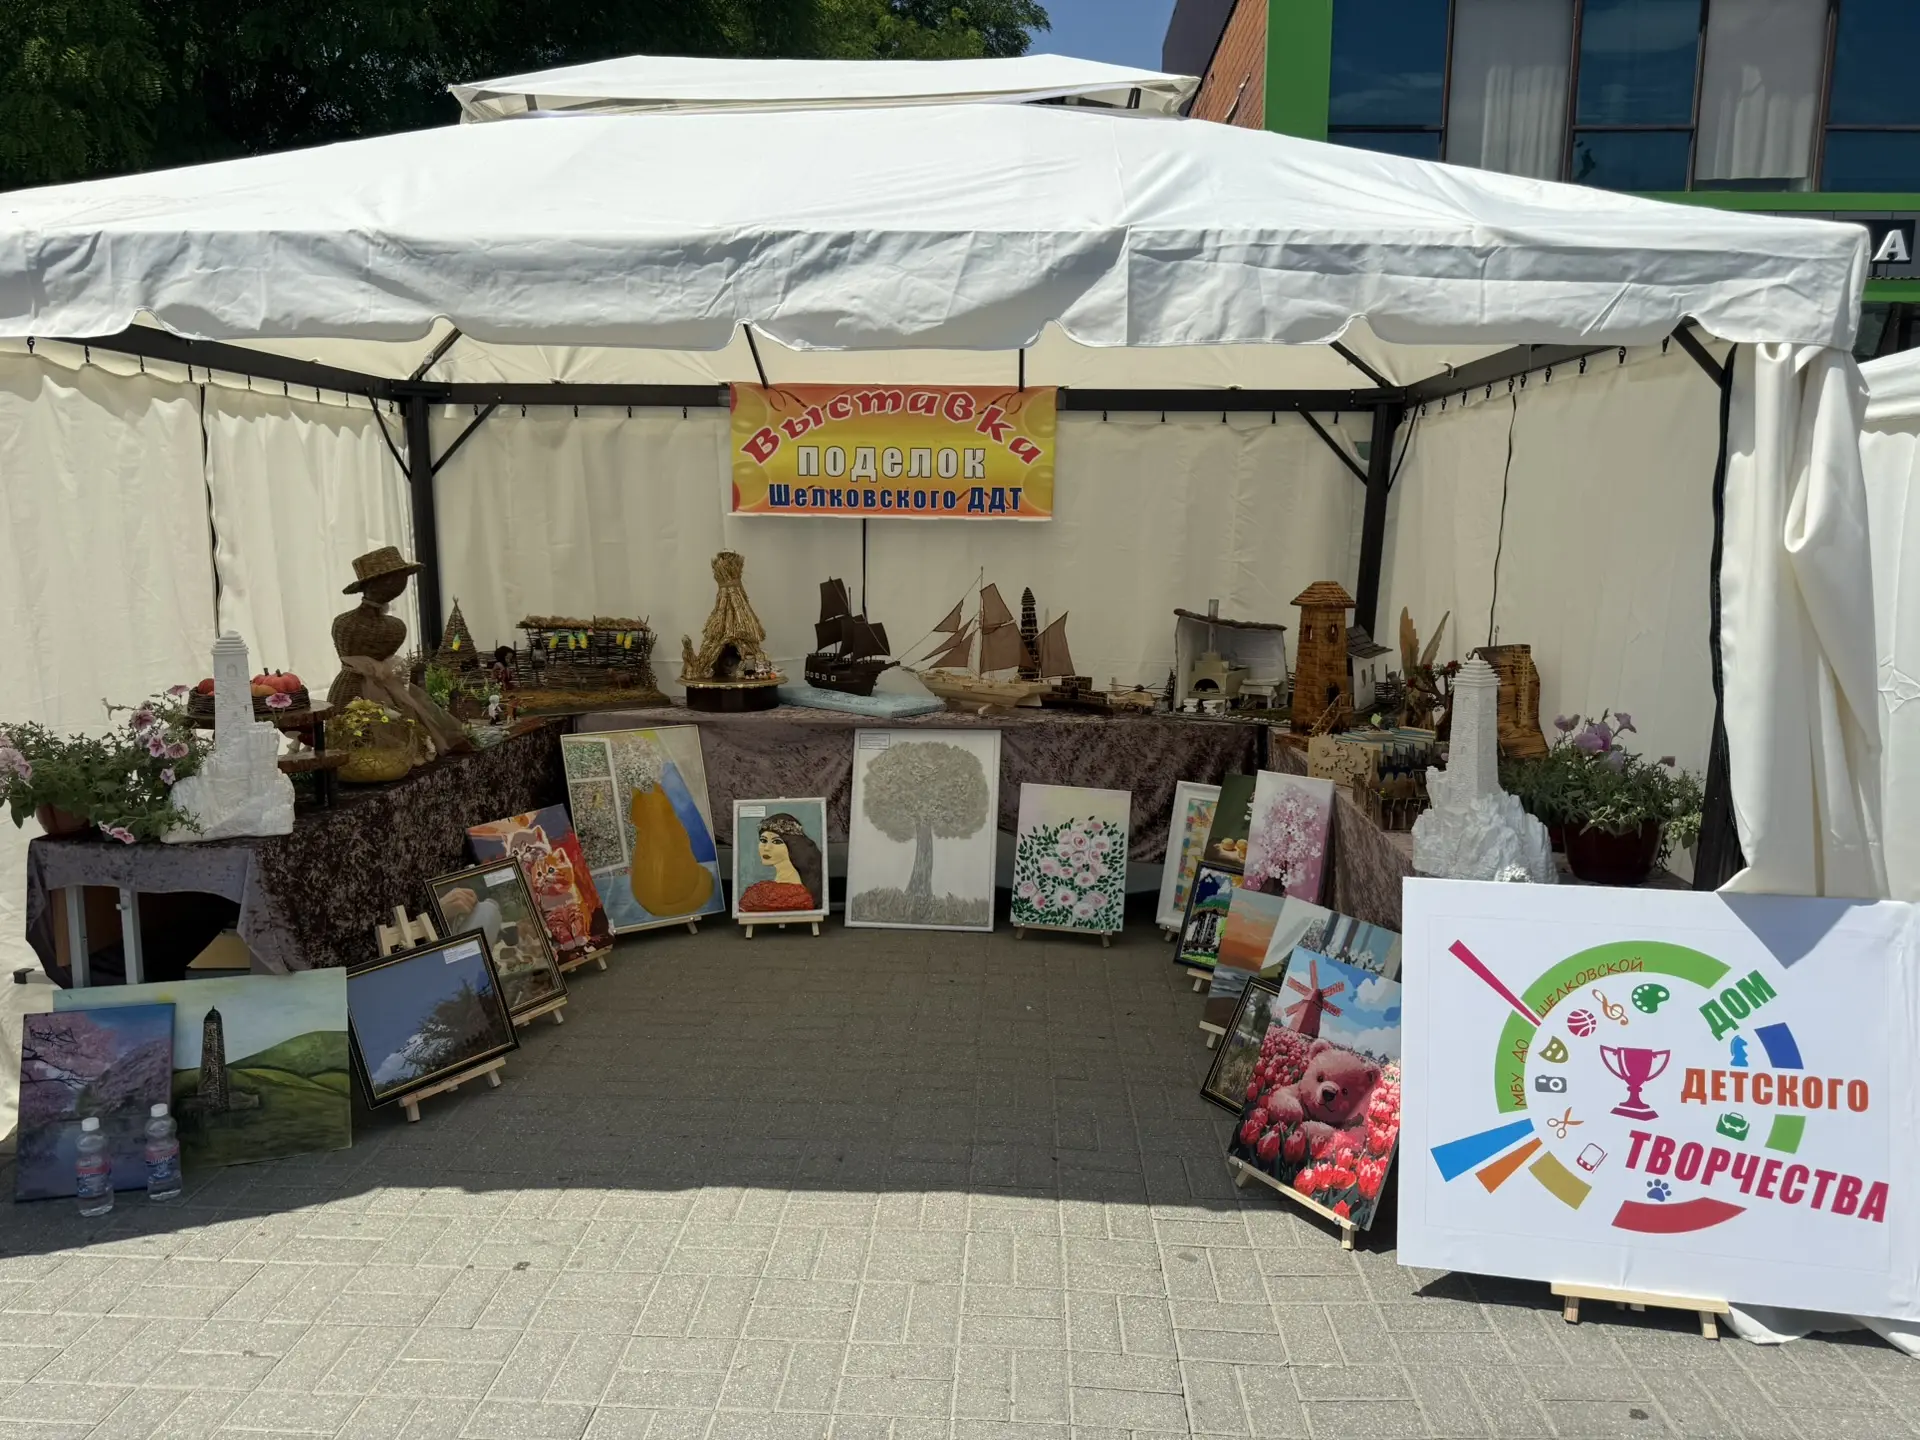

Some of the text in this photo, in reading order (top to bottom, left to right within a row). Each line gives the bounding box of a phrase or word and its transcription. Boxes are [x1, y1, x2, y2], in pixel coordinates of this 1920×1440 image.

[740, 389, 1044, 465] Выставка
[768, 484, 1023, 514] Шелковского ДДТ
[1698, 969, 1777, 1041] ДОМ
[1511, 1038, 1530, 1064] ДО
[1510, 1072, 1528, 1107] МБУ
[1680, 1067, 1870, 1113] ДЕТСКОГО
[1624, 1129, 1890, 1223] ТВОРЧЕСТВА
